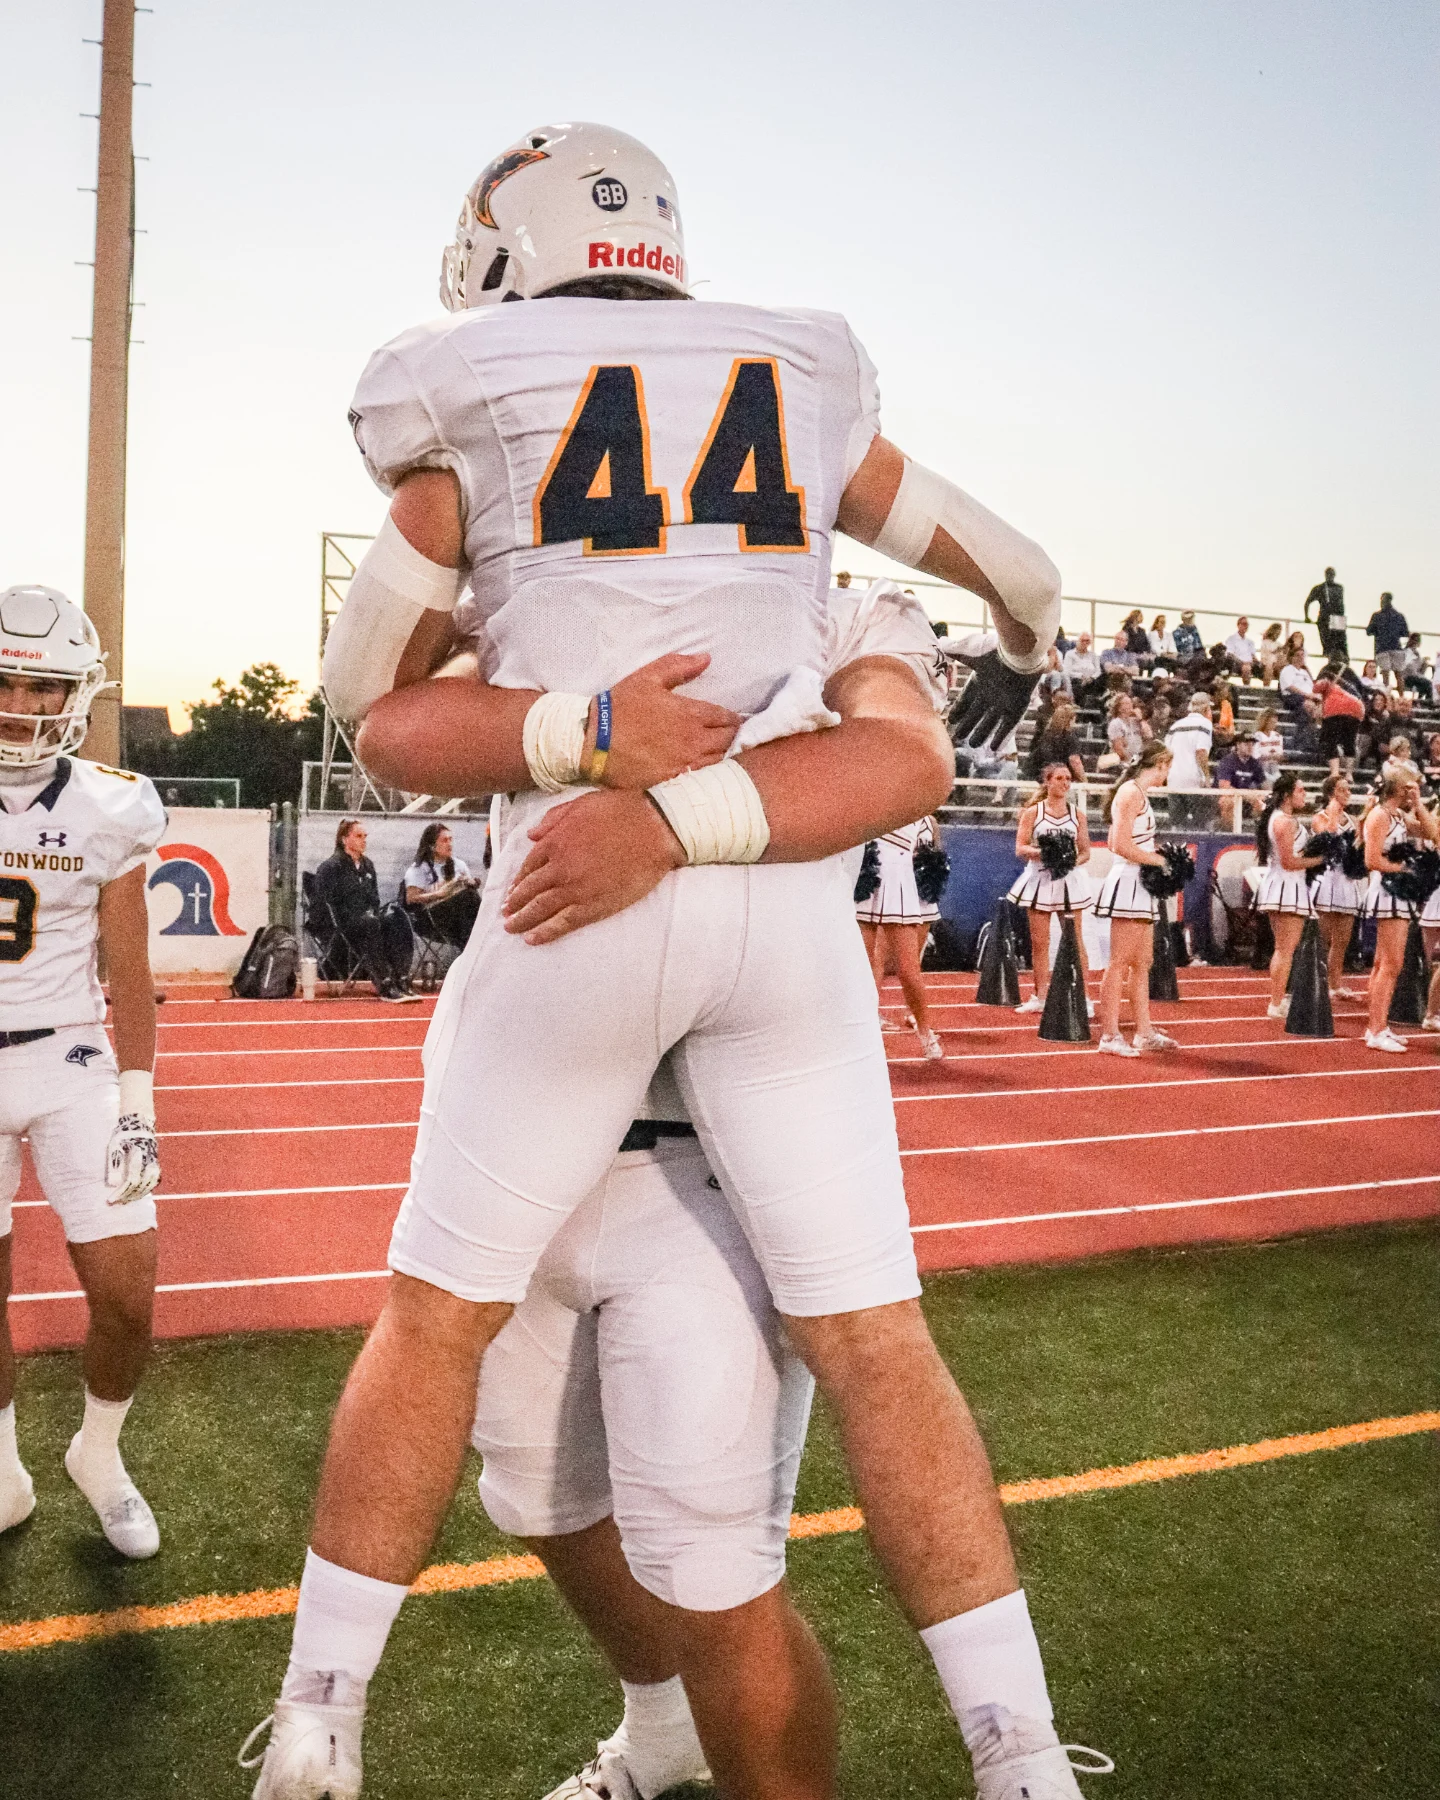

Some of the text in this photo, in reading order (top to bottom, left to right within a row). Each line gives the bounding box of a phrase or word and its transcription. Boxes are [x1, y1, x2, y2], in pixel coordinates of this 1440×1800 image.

[596, 184, 626, 206] BB
[588, 241, 684, 283] Riddell
[532, 357, 811, 557] 44
[0, 852, 84, 872] ONWOOD
